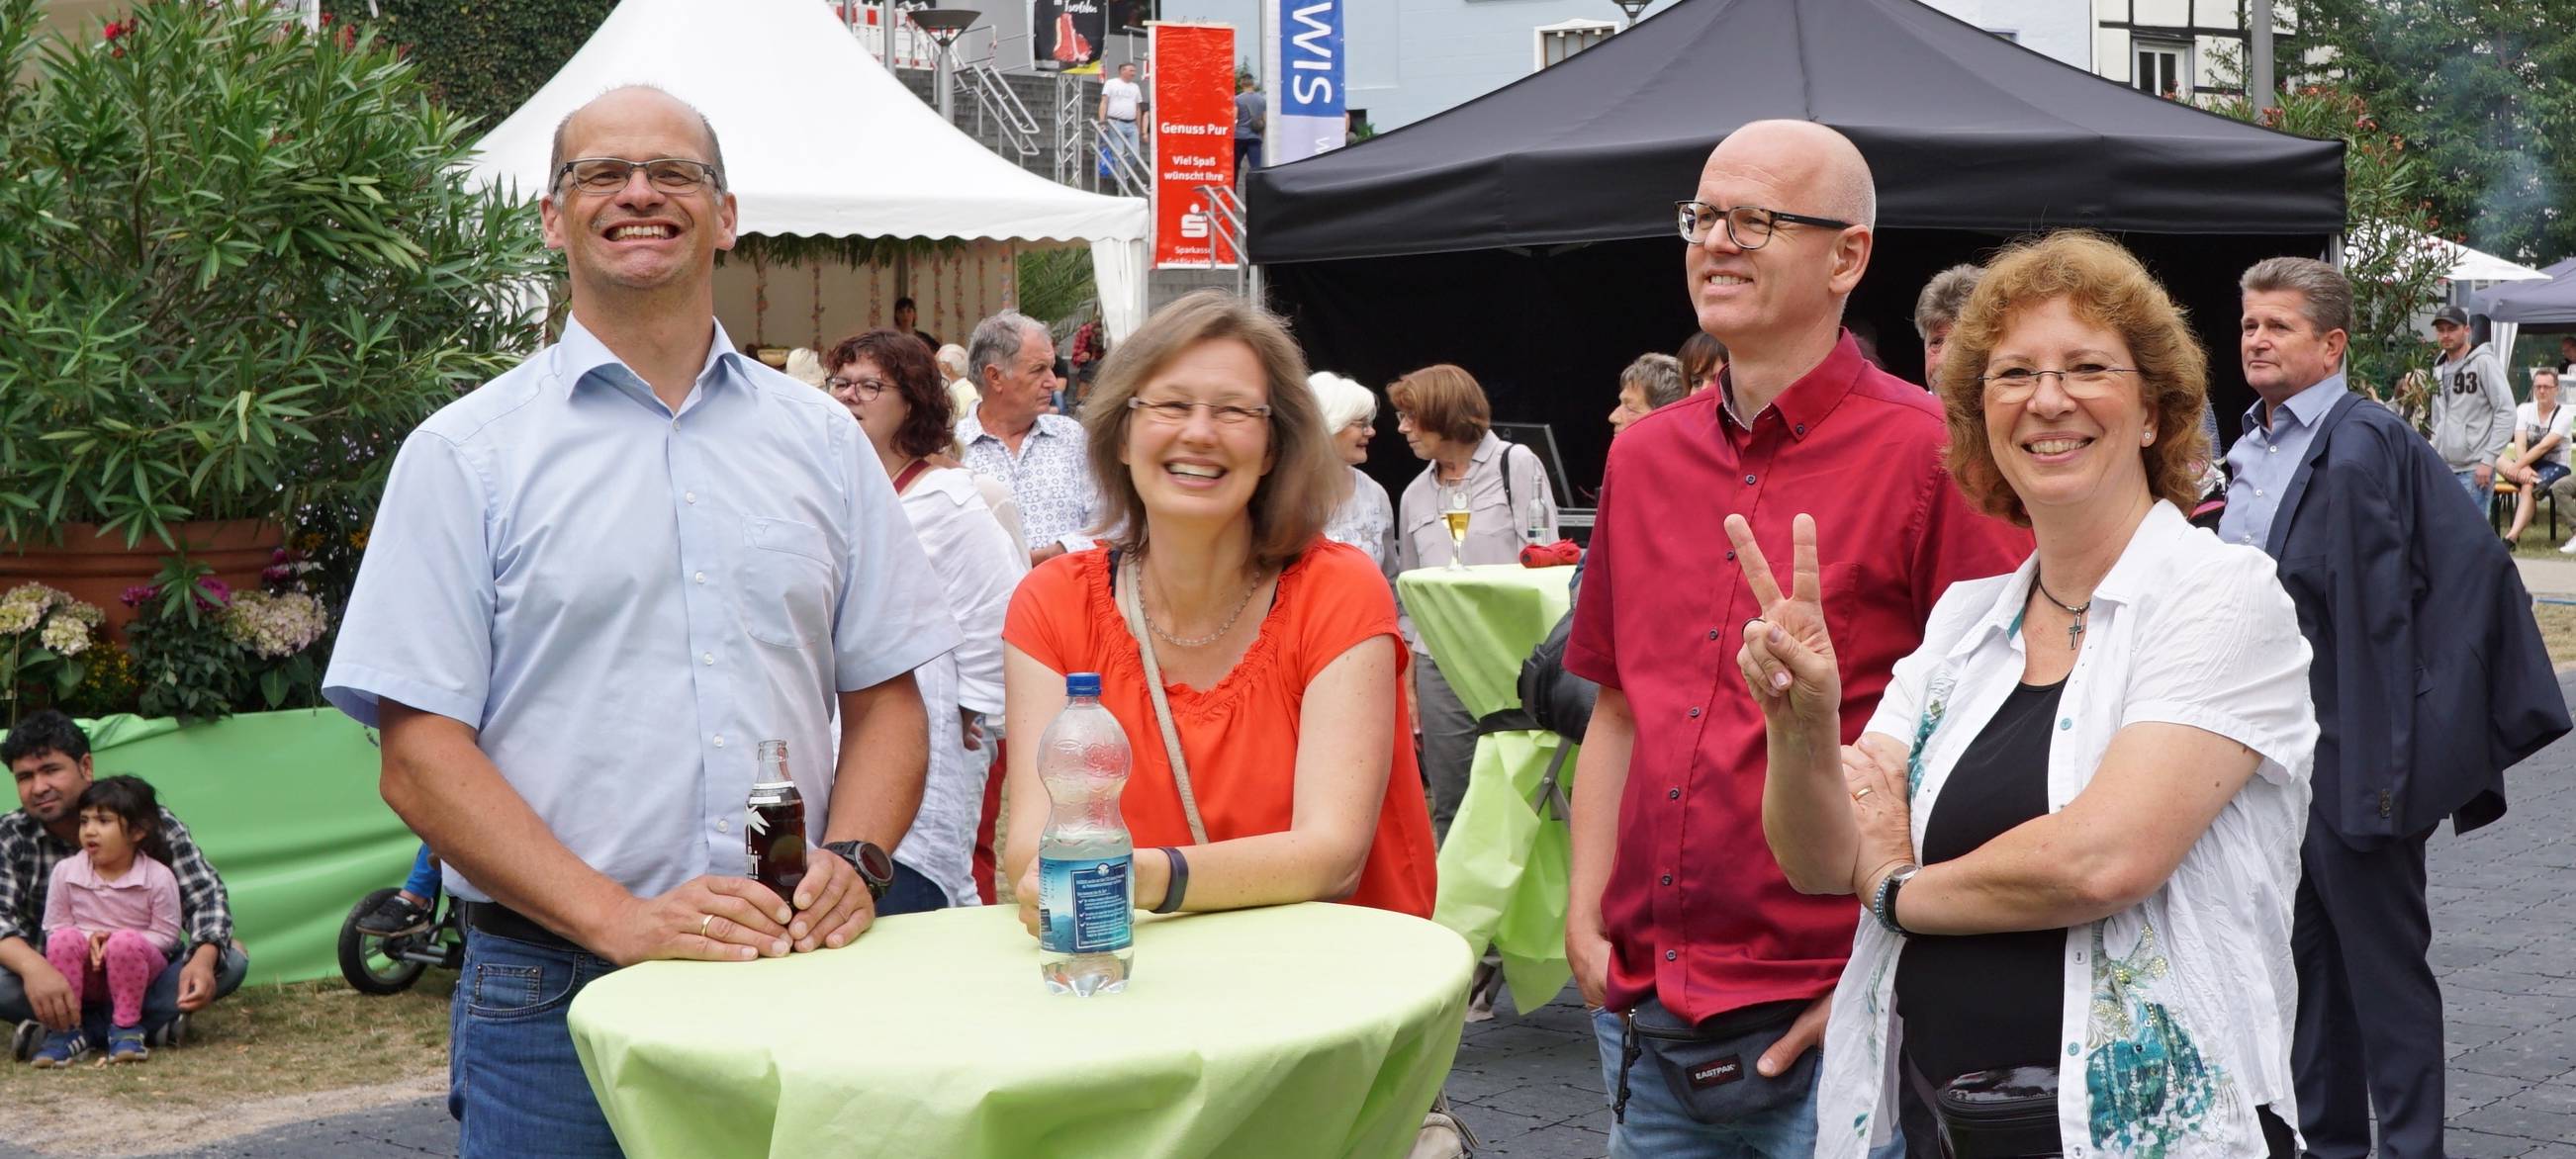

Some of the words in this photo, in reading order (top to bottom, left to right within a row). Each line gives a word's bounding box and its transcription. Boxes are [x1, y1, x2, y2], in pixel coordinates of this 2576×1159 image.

[1160, 122, 1205, 134] Genuss
[1207, 123, 1229, 135] Pur
[1172, 155, 1192, 166] Viel
[1193, 156, 1216, 168] Spaß
[1163, 170, 1204, 181] wünscht
[1206, 172, 1224, 182] Ihre
[2452, 371, 2478, 395] 93
[1695, 1063, 1734, 1080] EASTPAK
